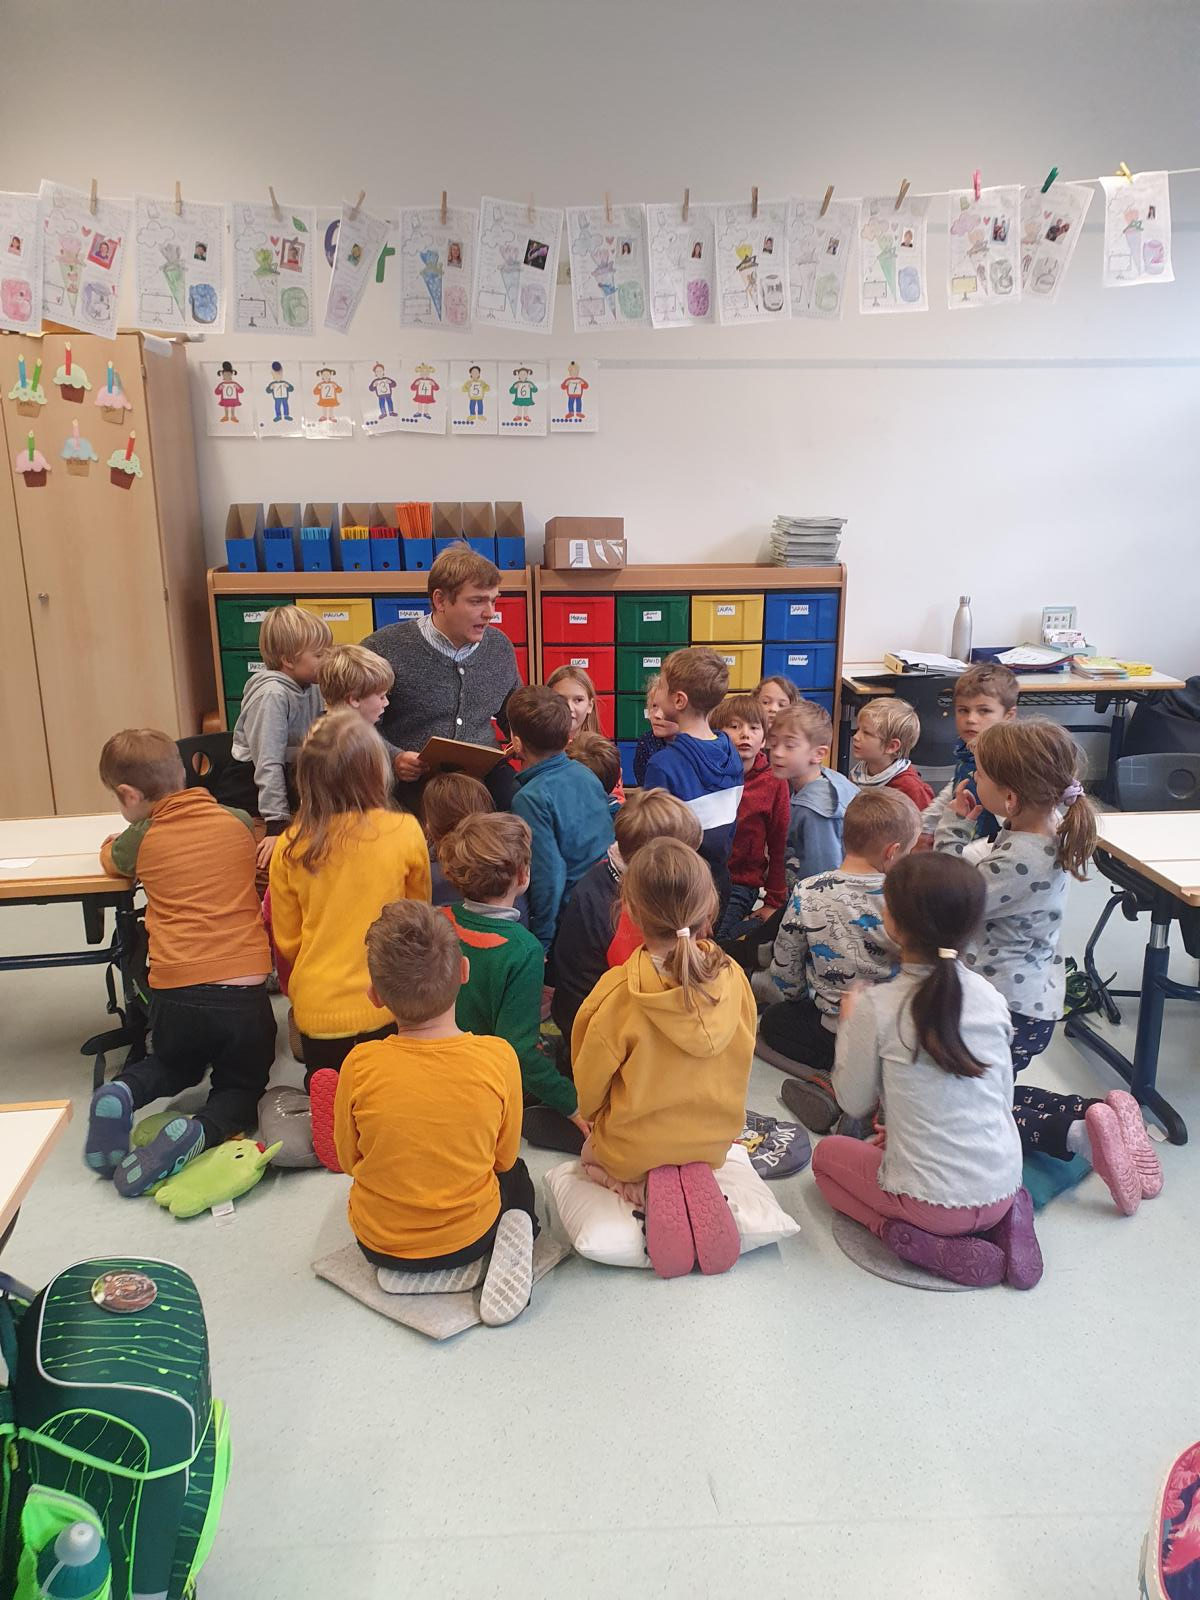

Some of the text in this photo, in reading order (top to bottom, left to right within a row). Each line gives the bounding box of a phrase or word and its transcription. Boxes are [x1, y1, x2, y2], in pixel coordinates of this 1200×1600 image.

[226, 386, 233, 397] 0
[325, 386, 331, 398] 2
[379, 381, 387, 393] 3
[421, 383, 428, 395] 4
[473, 384, 480, 396] 5
[520, 384, 527, 397] 6
[572, 382, 578, 394] 7
